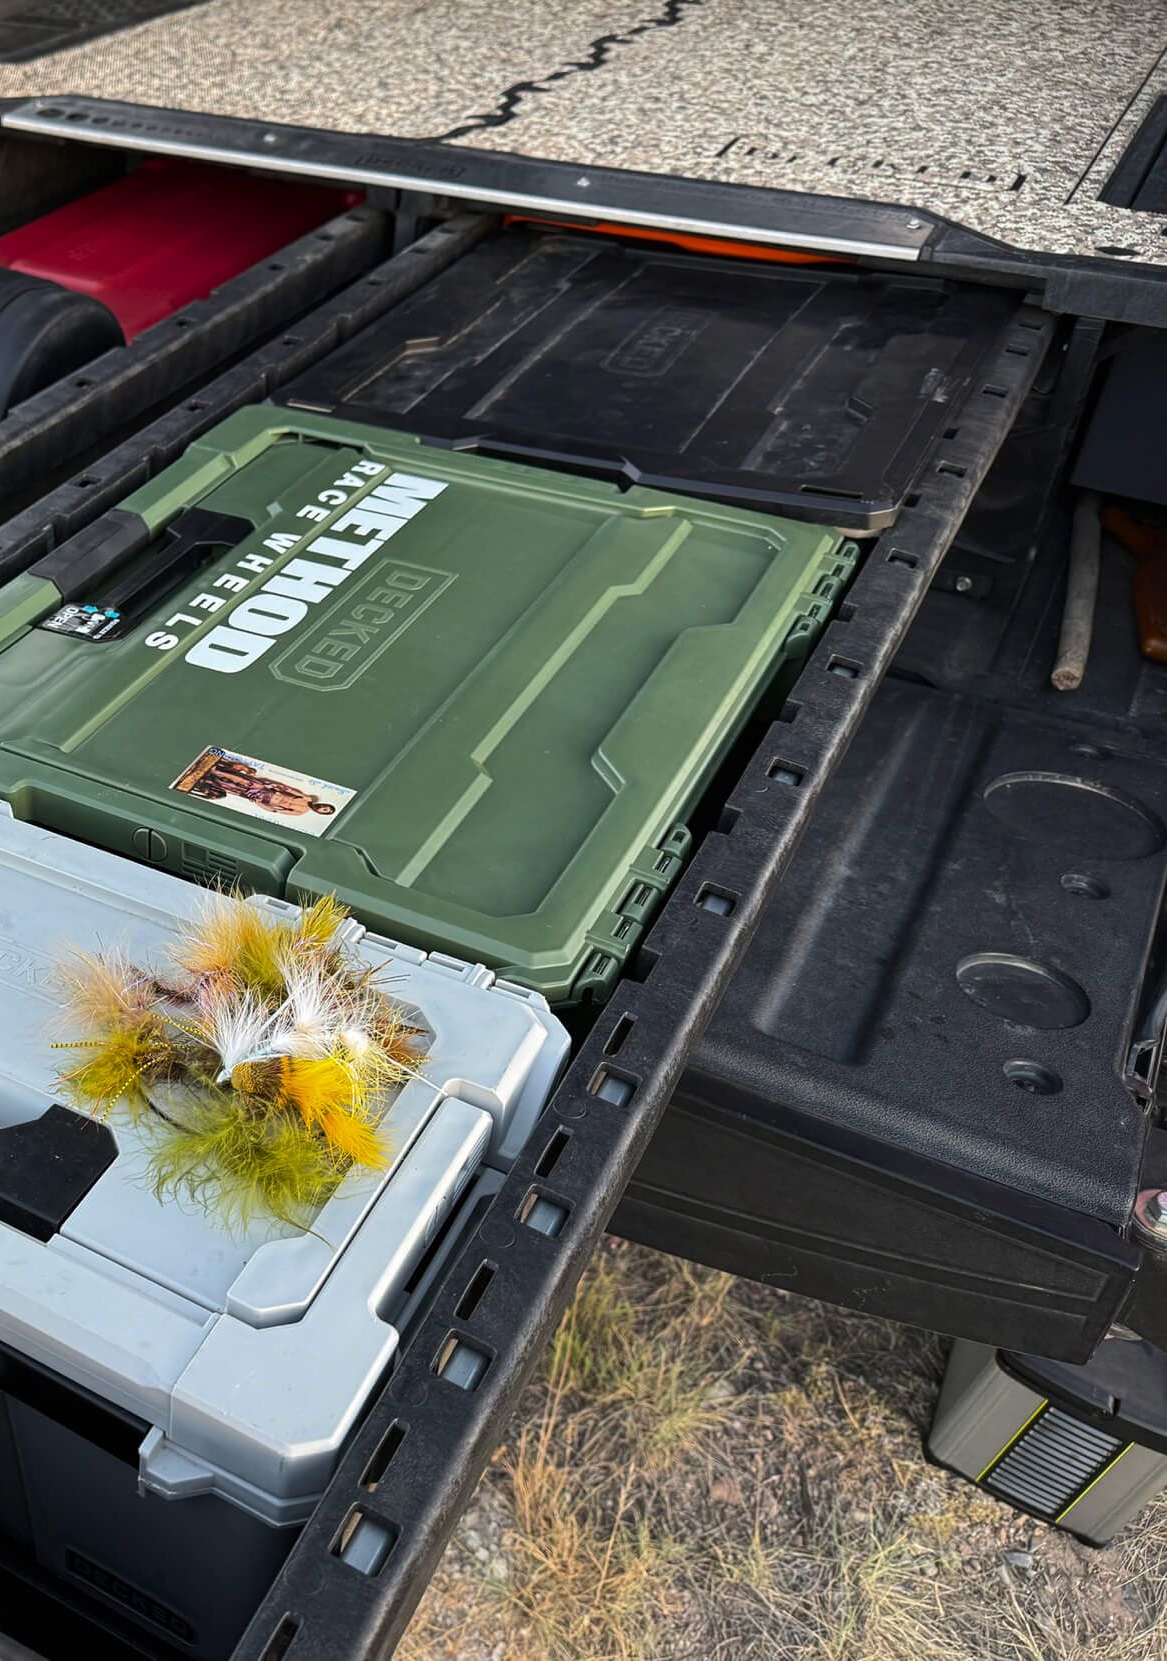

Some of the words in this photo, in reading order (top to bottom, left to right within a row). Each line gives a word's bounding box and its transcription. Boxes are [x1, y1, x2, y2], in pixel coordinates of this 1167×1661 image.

[296, 459, 386, 523] RACE
[46, 606, 80, 629] OPEN
[145, 532, 303, 651] WHEELS
[184, 471, 450, 674] METHOD
[294, 568, 432, 680] DECKED
